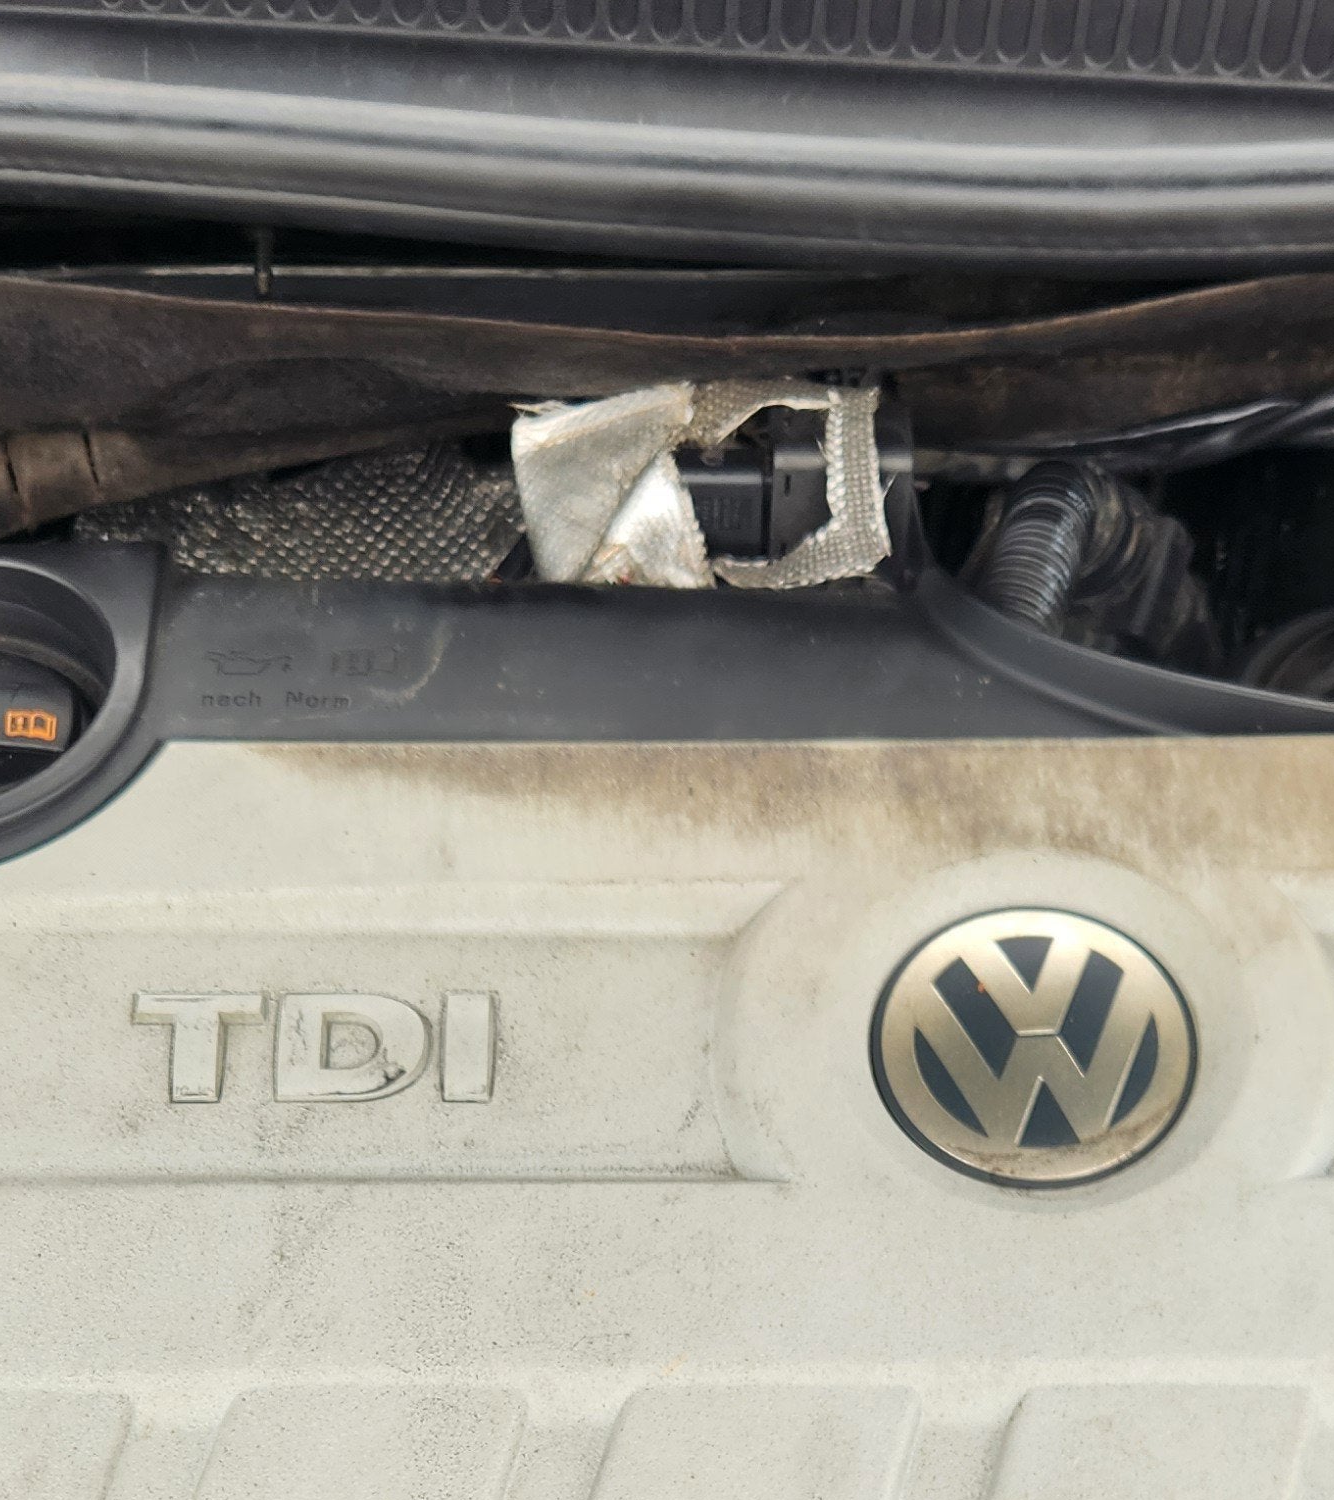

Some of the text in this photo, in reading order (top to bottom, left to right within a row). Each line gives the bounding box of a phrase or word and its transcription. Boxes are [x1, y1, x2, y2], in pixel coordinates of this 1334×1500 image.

[202, 690, 350, 708] nach Norm
[132, 990, 499, 1104] TDI
